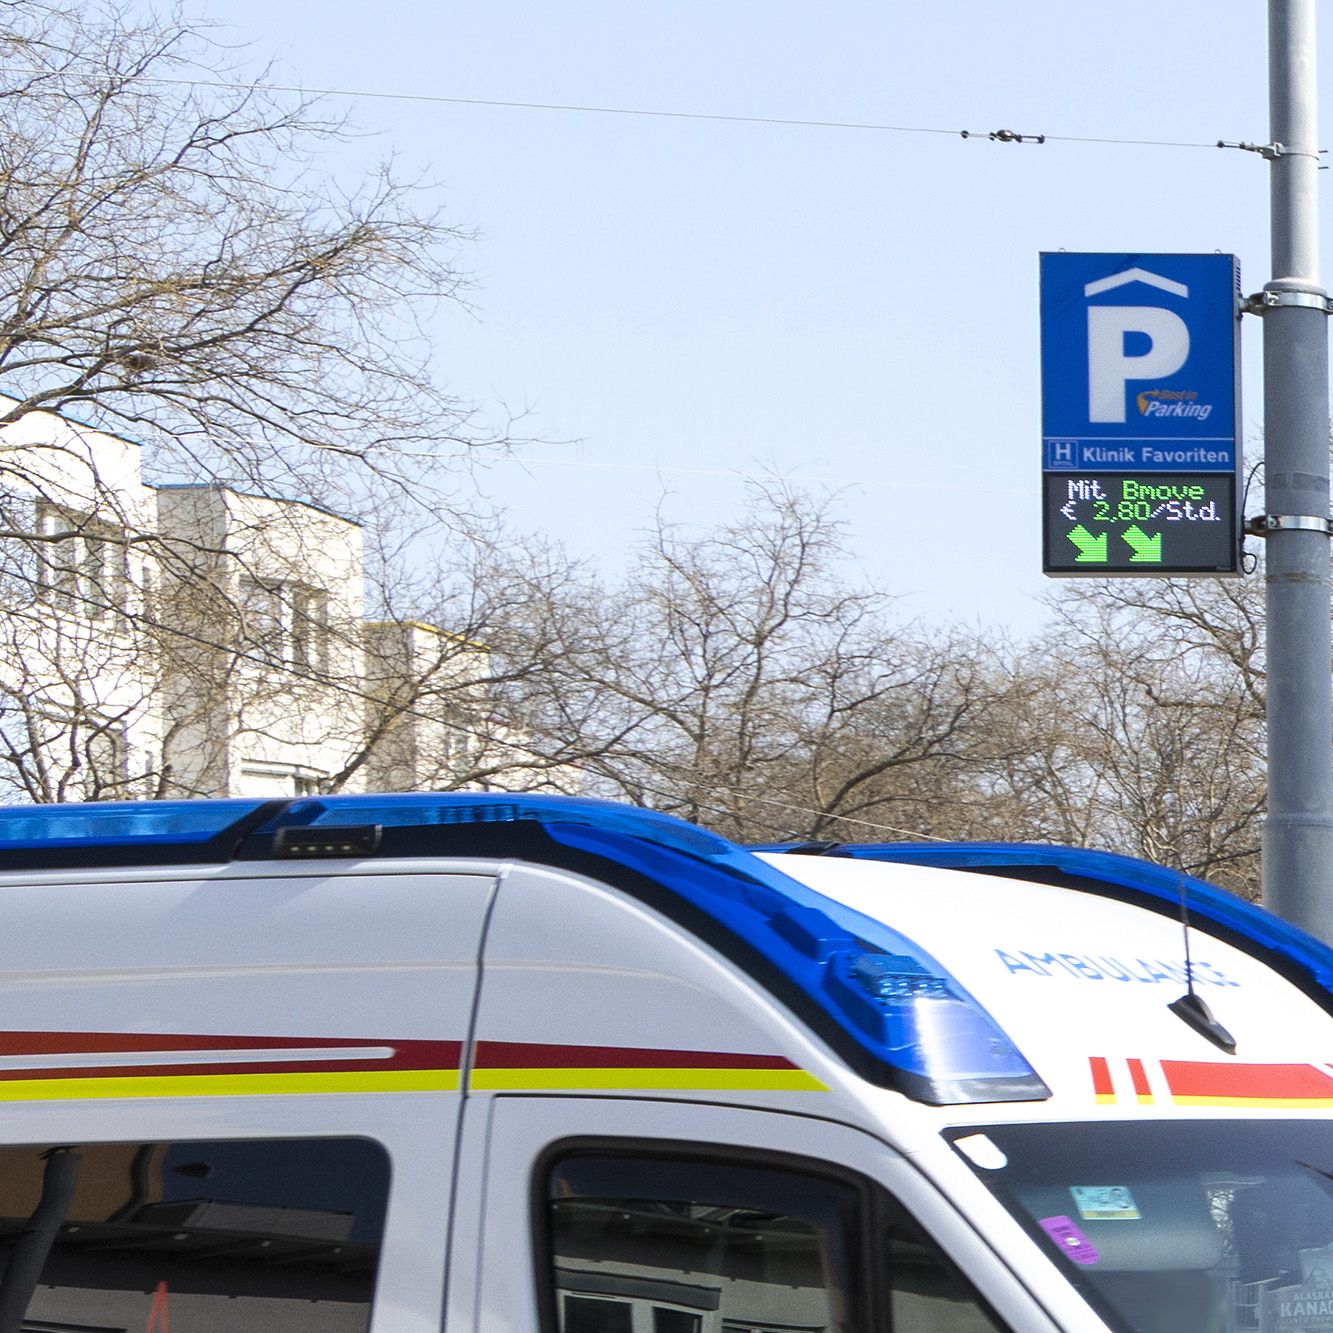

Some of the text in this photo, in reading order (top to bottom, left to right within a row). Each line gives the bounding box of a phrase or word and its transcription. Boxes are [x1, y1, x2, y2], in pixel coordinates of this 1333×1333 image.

[1087, 306, 1190, 424] P
[1144, 401, 1213, 421] Parking
[1055, 443, 1229, 463] H Klinik Favoriten
[1068, 480, 1205, 500] Mit Bmove
